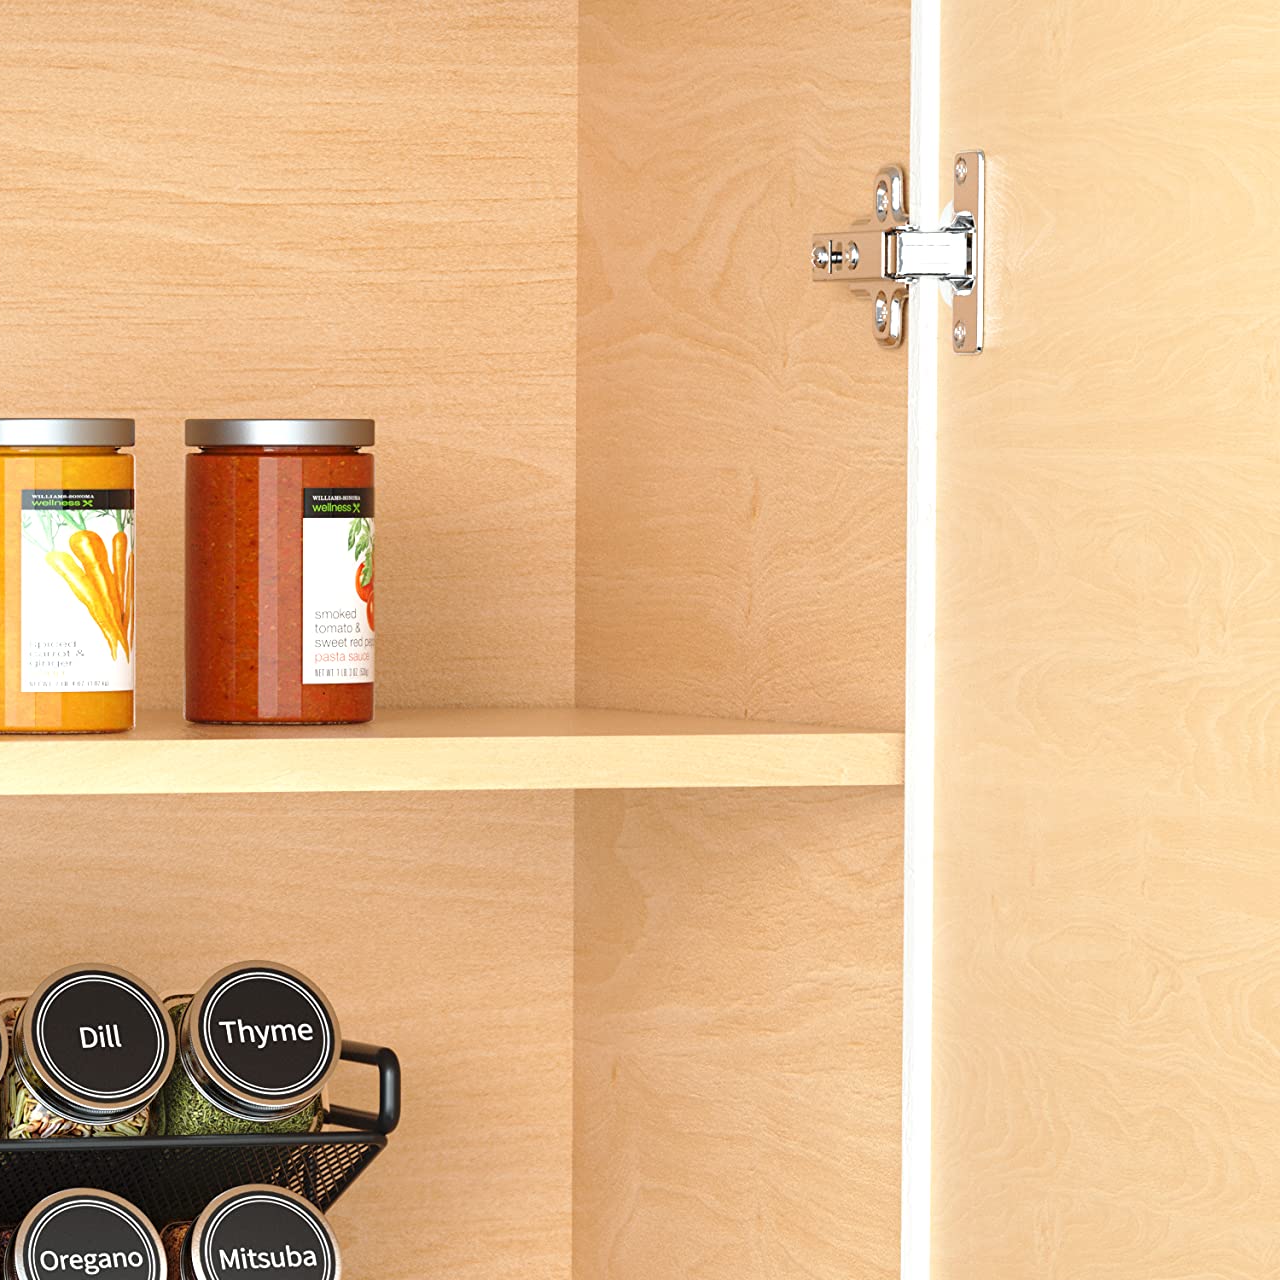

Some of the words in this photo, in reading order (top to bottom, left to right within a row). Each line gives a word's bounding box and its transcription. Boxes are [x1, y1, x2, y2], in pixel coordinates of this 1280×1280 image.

[31, 499, 81, 507] wellness
[312, 502, 352, 513] wellness
[314, 607, 357, 620] smoked
[314, 623, 353, 634] tomato
[354, 622, 361, 633] &
[314, 637, 348, 648] sweet
[349, 636, 363, 647] red
[314, 651, 346, 664] pasta
[79, 1024, 122, 1049] Dill
[218, 1018, 314, 1049] Thyme
[39, 1250, 144, 1275] Oregano
[218, 1244, 318, 1271] Mitsuba
